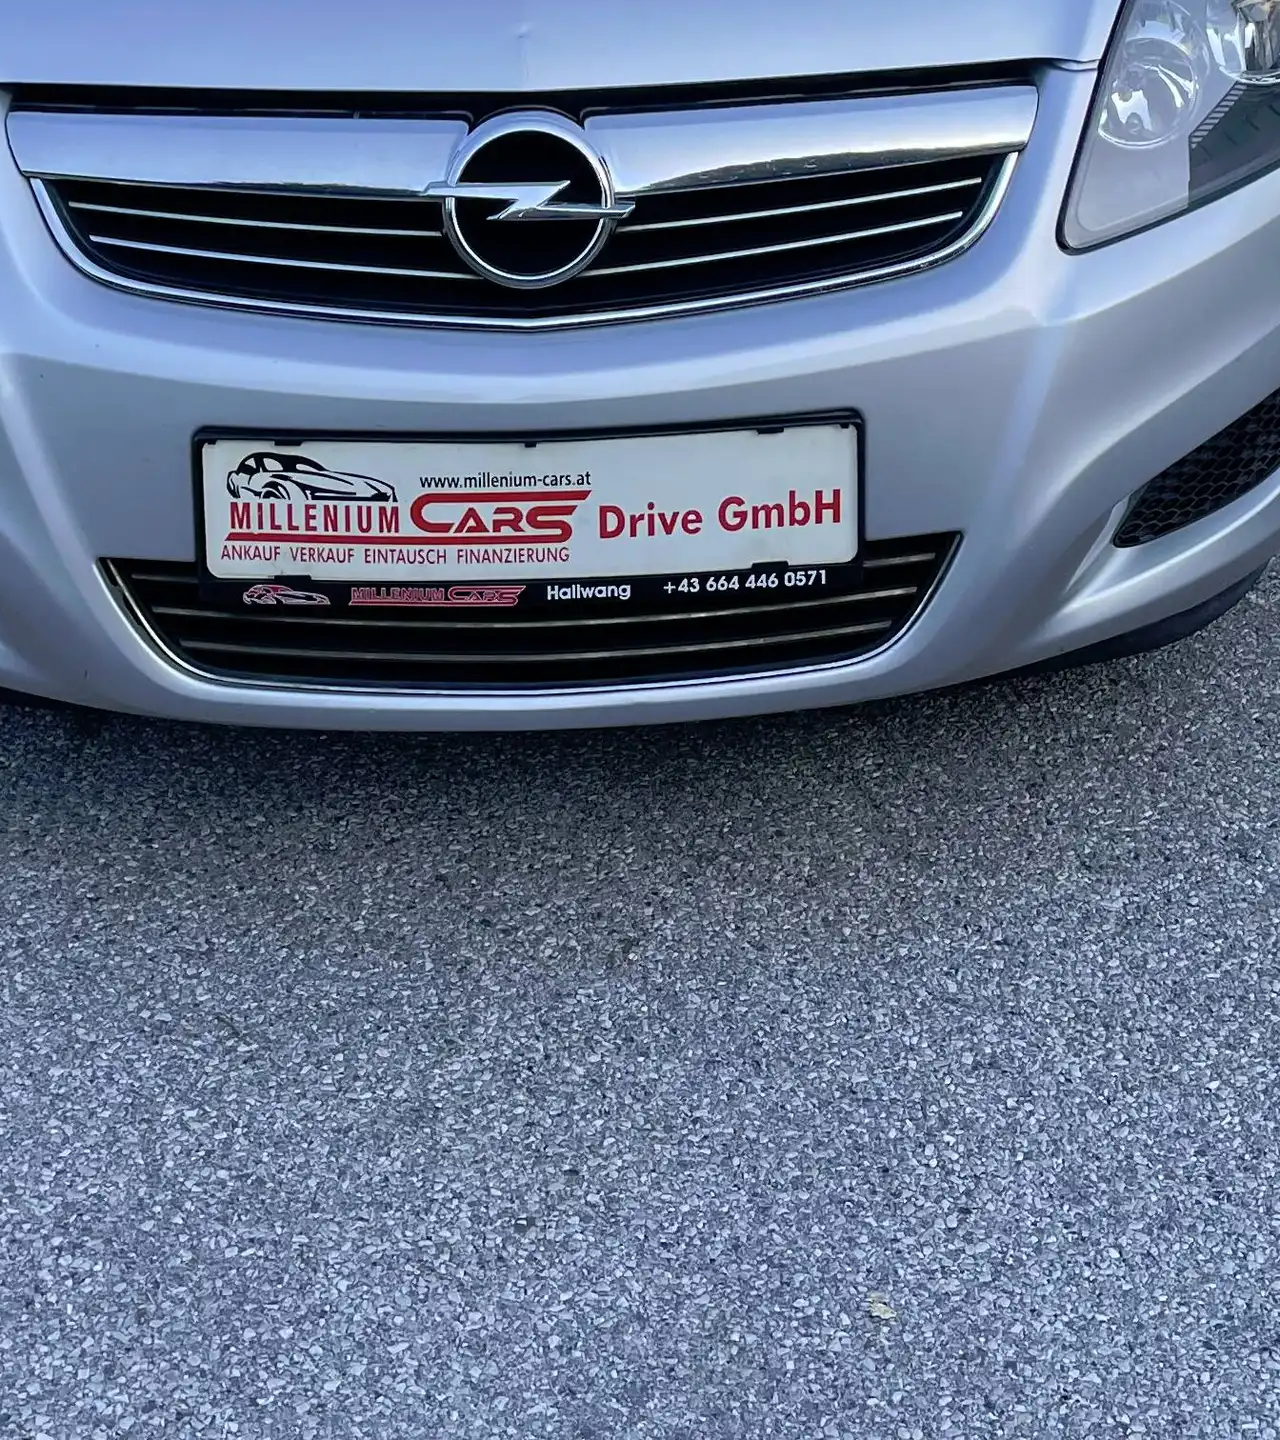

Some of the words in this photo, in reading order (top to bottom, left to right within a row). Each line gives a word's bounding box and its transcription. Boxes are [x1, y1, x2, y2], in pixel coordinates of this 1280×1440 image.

[419, 471, 592, 489] www.millenium-cars.at
[229, 501, 400, 534] MILLENIUM
[410, 490, 592, 542] CARS
[599, 501, 704, 540] Drive
[718, 488, 842, 533] GmbH
[220, 544, 282, 562] ANKAUF
[289, 546, 356, 564] VERKAUF
[363, 547, 448, 565] EINTAUSCH
[456, 546, 570, 565] FINANZIERUNG
[546, 583, 632, 601] Hallwang
[662, 577, 701, 594] +43
[705, 574, 740, 592] 664
[744, 572, 778, 589] 446
[784, 569, 828, 588] 0571
[351, 586, 446, 602] MILLENIUM
